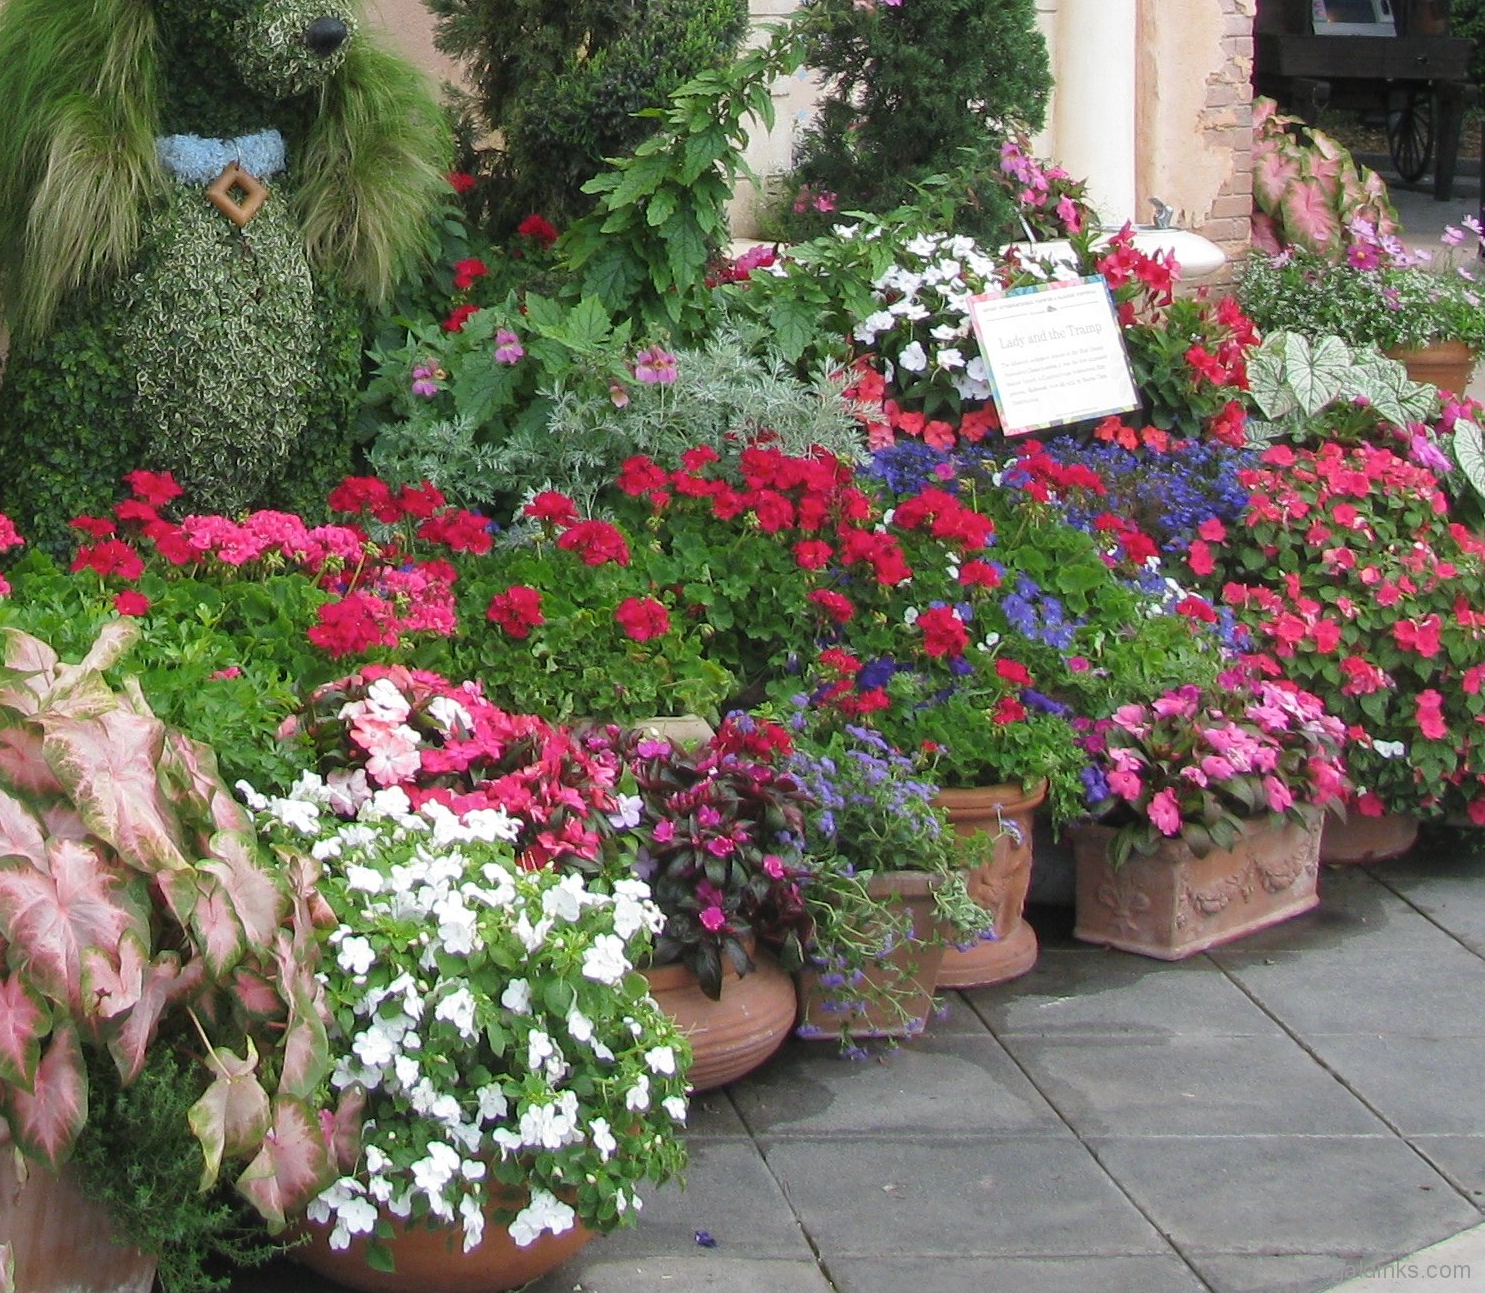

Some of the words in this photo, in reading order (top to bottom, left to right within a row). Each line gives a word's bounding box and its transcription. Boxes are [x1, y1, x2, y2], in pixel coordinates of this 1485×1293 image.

[998, 333, 1026, 349] Lady
[1028, 330, 1048, 344] and
[1049, 327, 1066, 340] the
[1066, 323, 1103, 337] Tramp
